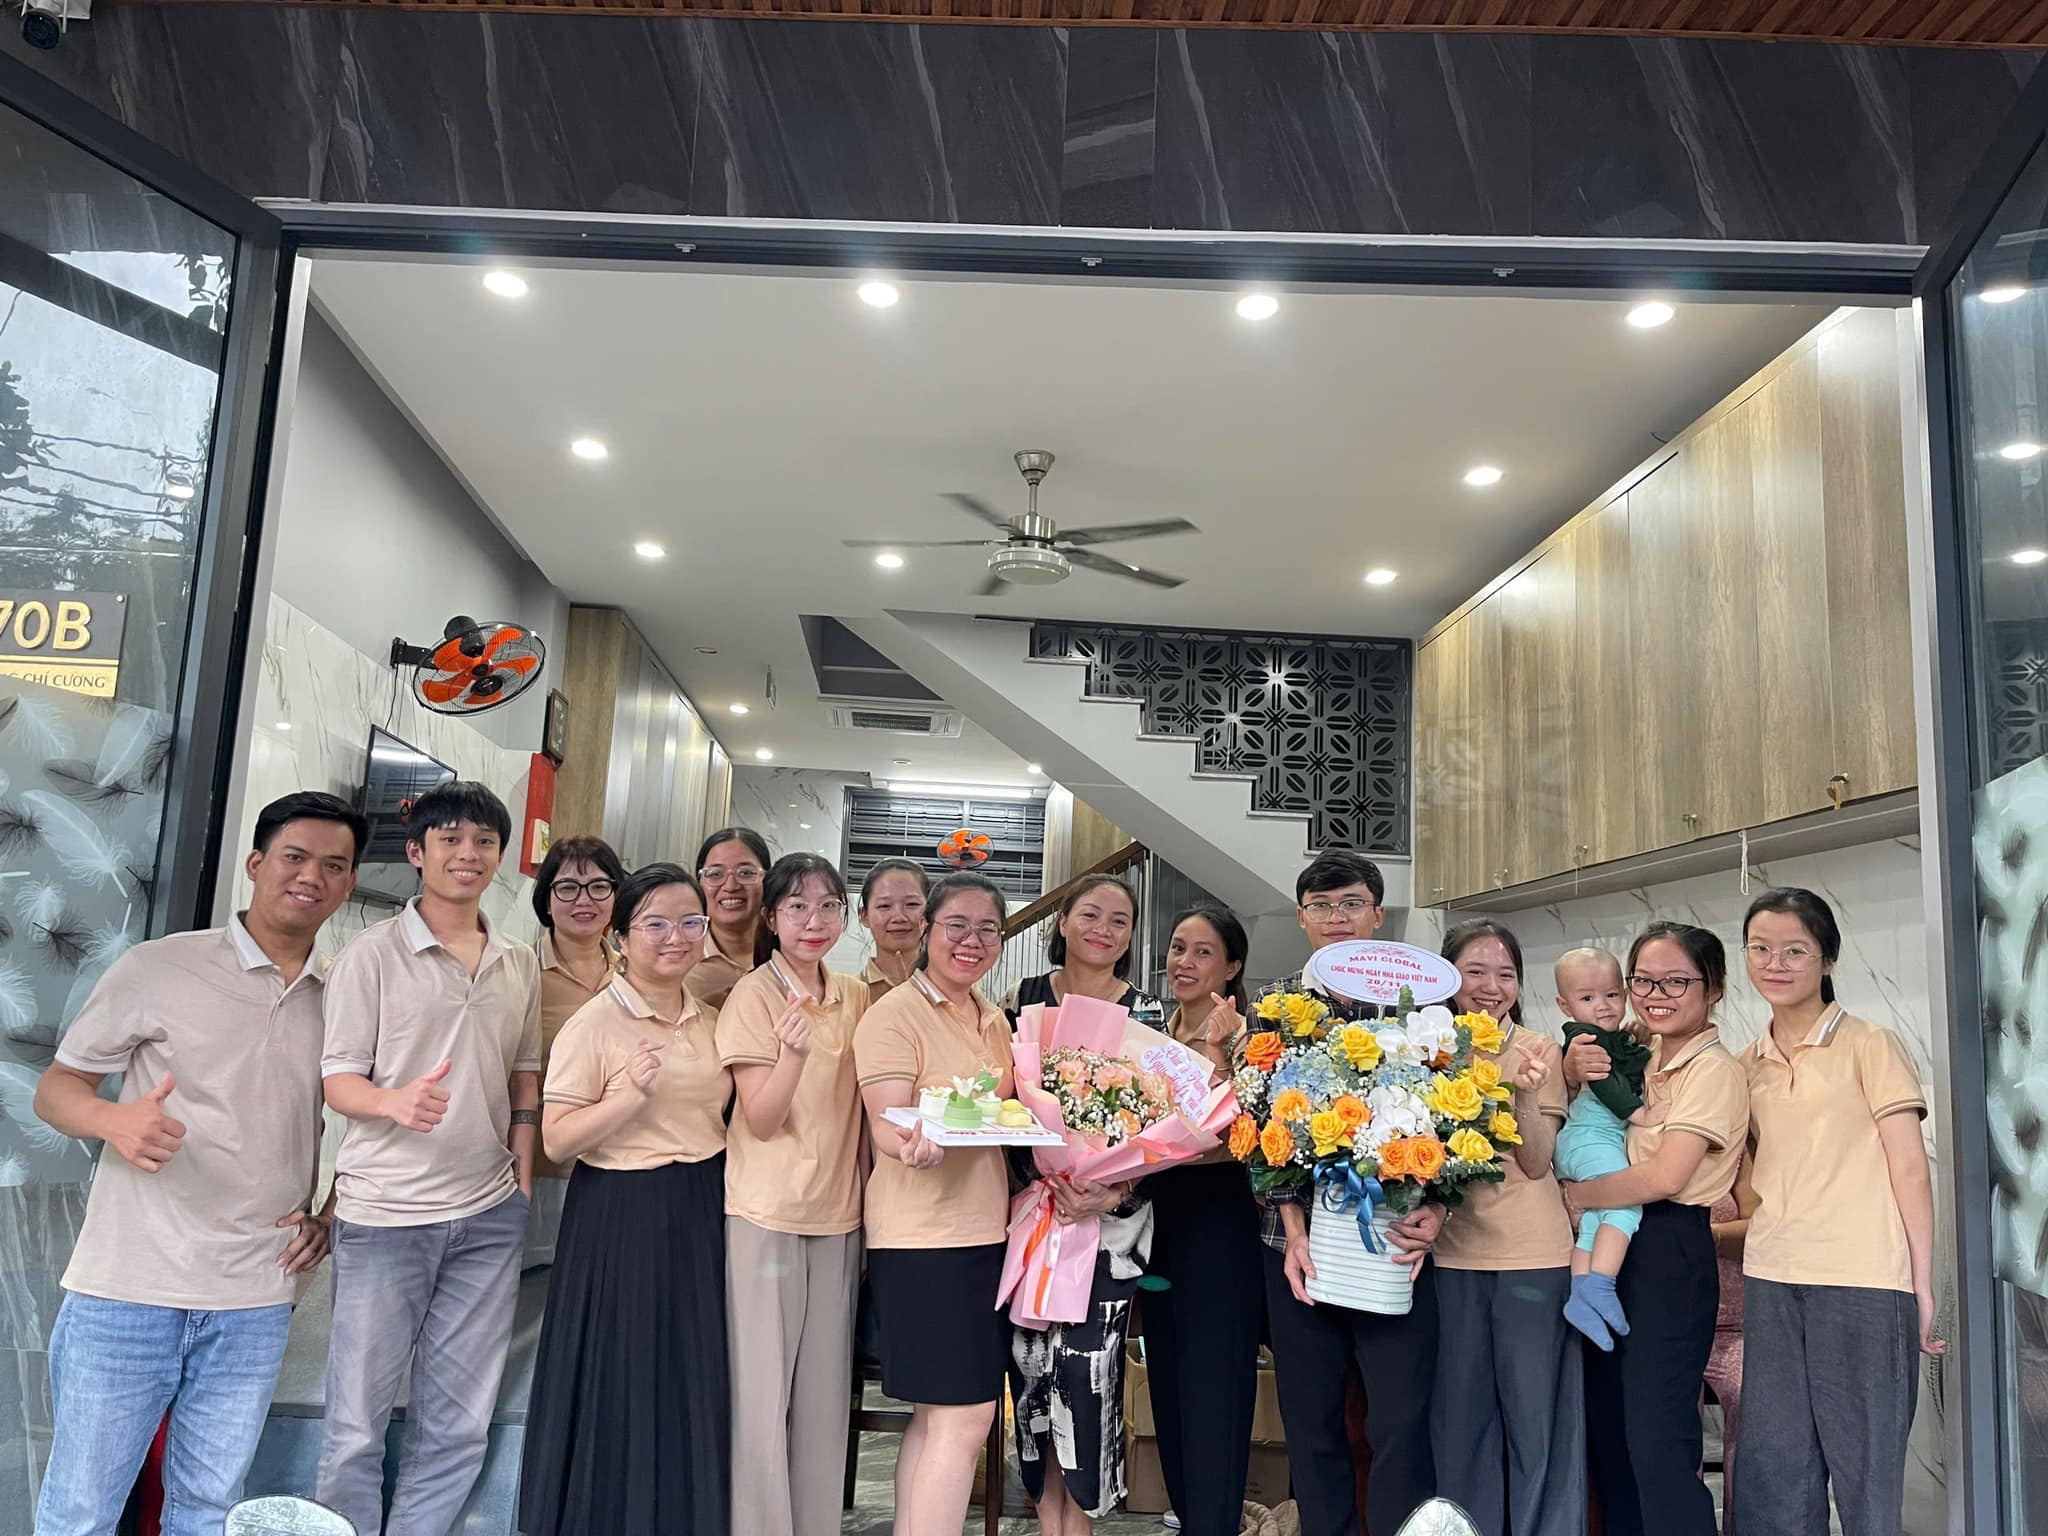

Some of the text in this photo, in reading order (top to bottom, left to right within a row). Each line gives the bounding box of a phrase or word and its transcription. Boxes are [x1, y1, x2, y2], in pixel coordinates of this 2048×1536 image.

[1381, 956, 1422, 971] GLOBAL
[1367, 978, 1401, 988] 20/11
[1424, 975, 1438, 984] NAM
